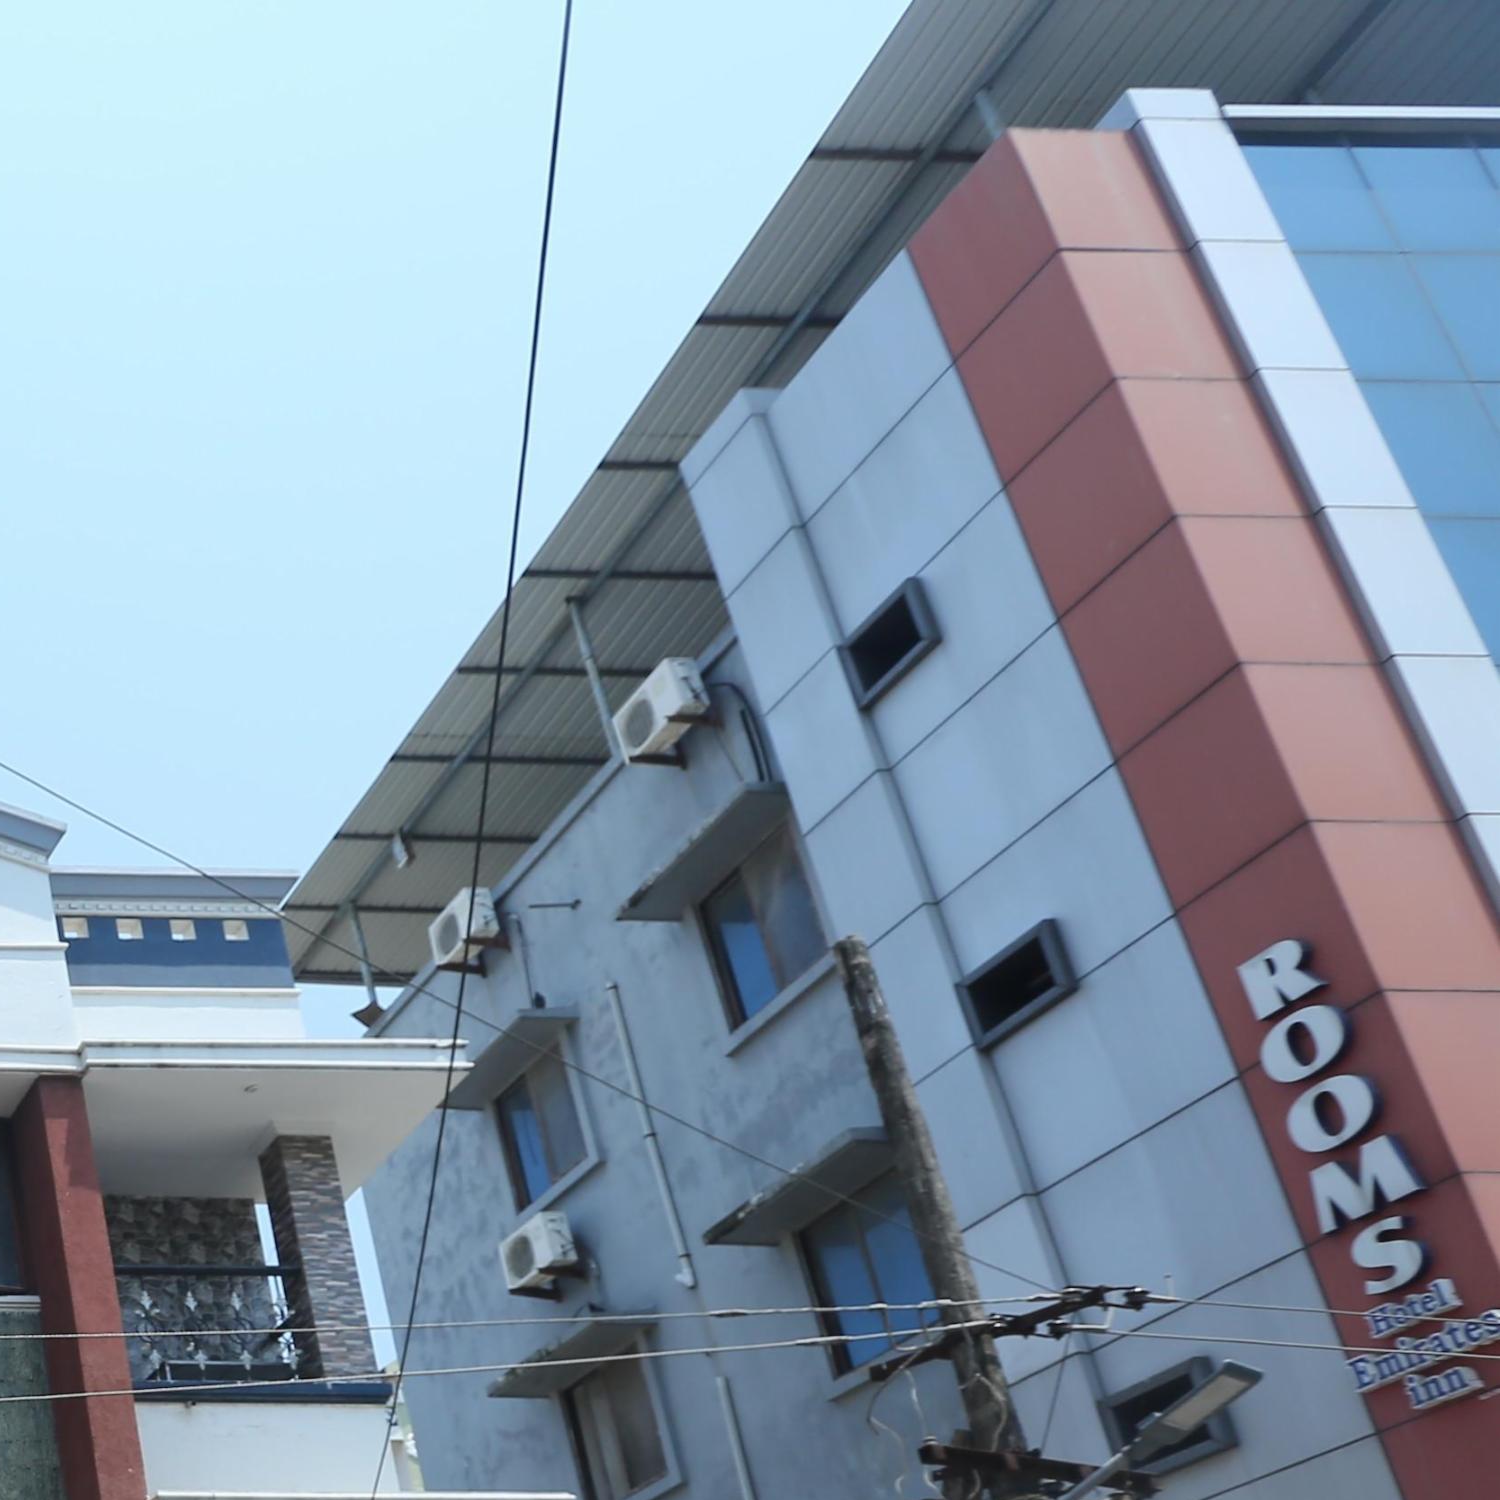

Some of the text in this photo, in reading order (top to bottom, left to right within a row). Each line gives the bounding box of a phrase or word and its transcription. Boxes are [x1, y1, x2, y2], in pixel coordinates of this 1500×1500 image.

[1236, 939, 1428, 1295] ROOMS
[1366, 1281, 1450, 1336] Hotel
[1346, 1310, 1500, 1390] Emirates
[1405, 1367, 1470, 1406] inn
